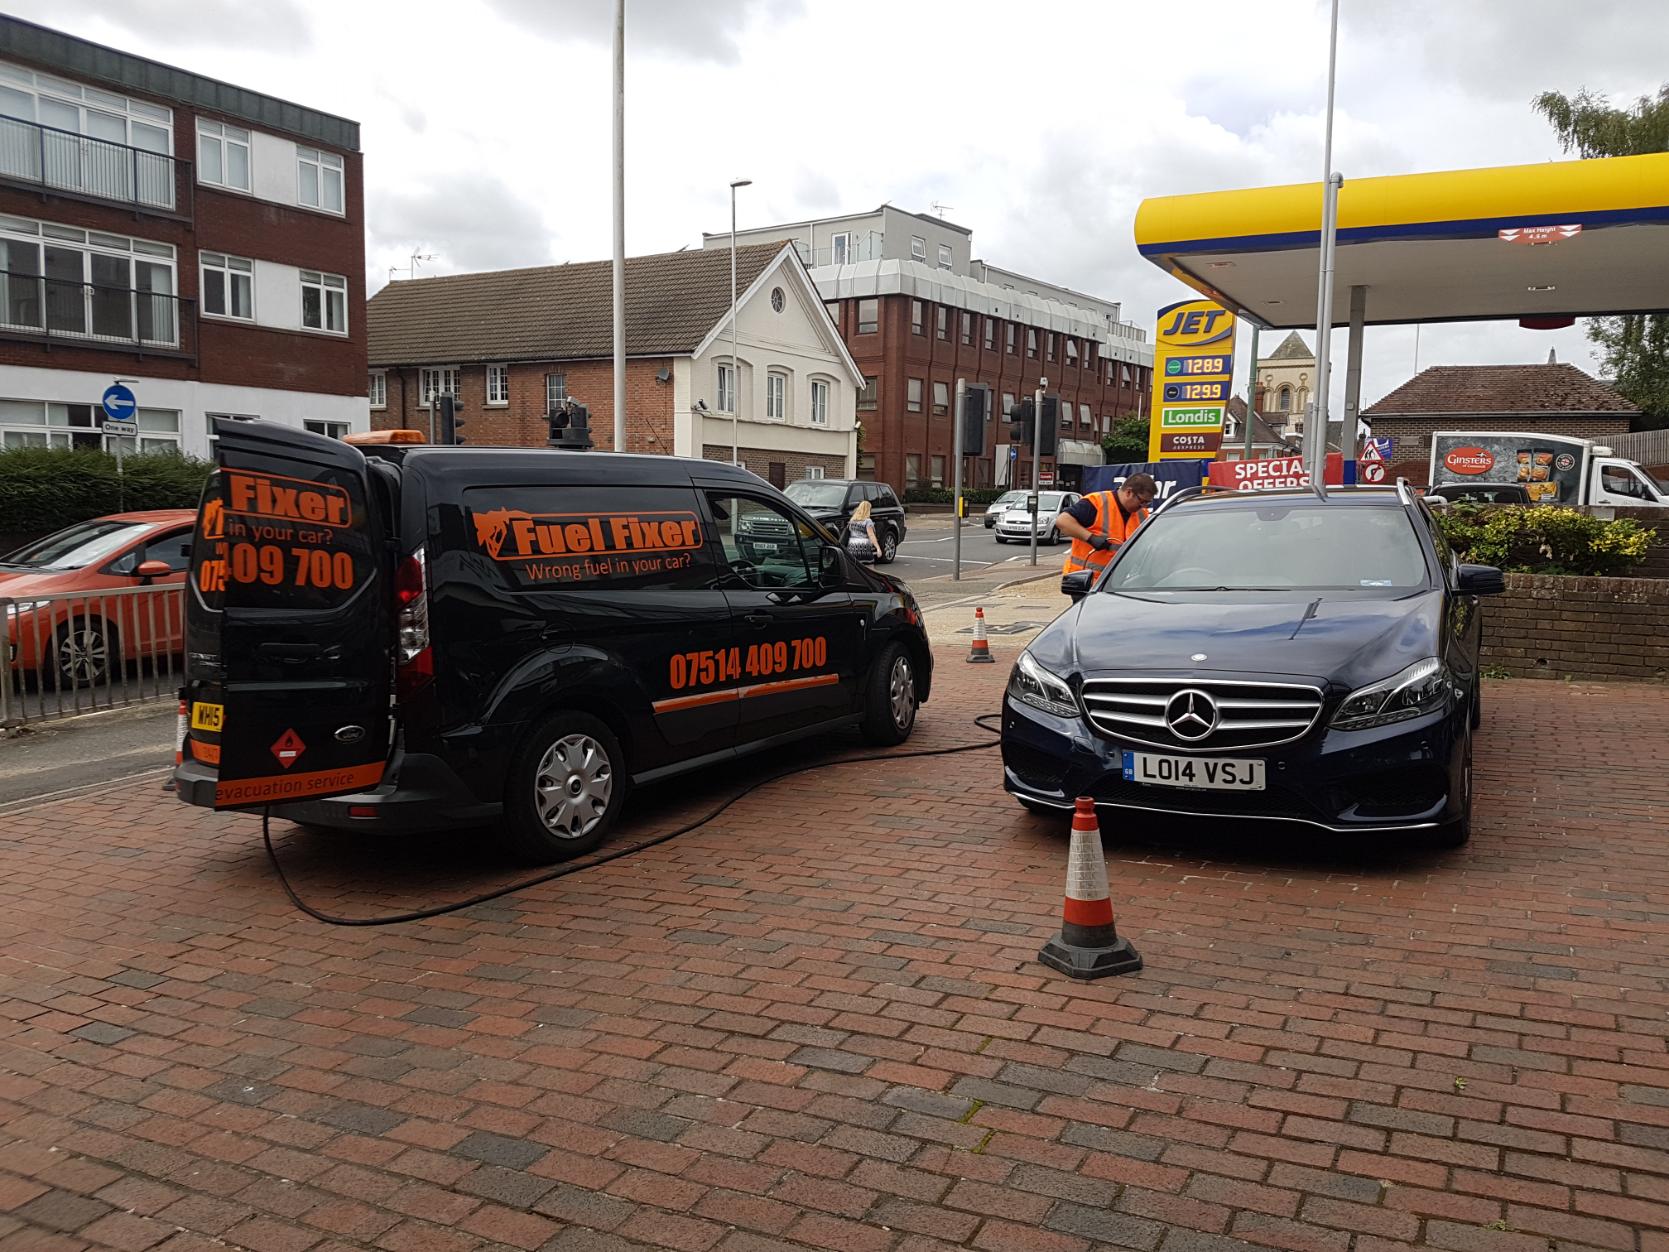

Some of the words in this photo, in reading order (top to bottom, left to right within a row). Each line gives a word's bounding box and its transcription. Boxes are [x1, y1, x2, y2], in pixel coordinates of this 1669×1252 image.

[1163, 310, 1225, 335] JET
[1168, 409, 1216, 423] Londis
[1173, 436, 1205, 444] COSTA
[1235, 459, 1310, 479] SPECIA
[230, 475, 345, 523] Fixer
[228, 519, 246, 537] in
[252, 525, 293, 542] your
[299, 529, 333, 545] car?
[512, 518, 606, 555] Fuel
[609, 517, 697, 550] Fixer
[291, 548, 353, 589] 700
[525, 563, 581, 581] Wrong
[584, 559, 612, 577] fuel
[616, 558, 629, 573] in
[633, 557, 662, 576] your
[665, 552, 692, 569] car?
[669, 647, 741, 689] 07514
[746, 641, 787, 677] 409
[791, 636, 827, 670] 700
[1142, 757, 1196, 782] LO14
[1204, 762, 1254, 785] VSJ
[216, 779, 303, 800] evacuation
[307, 772, 354, 790] service
